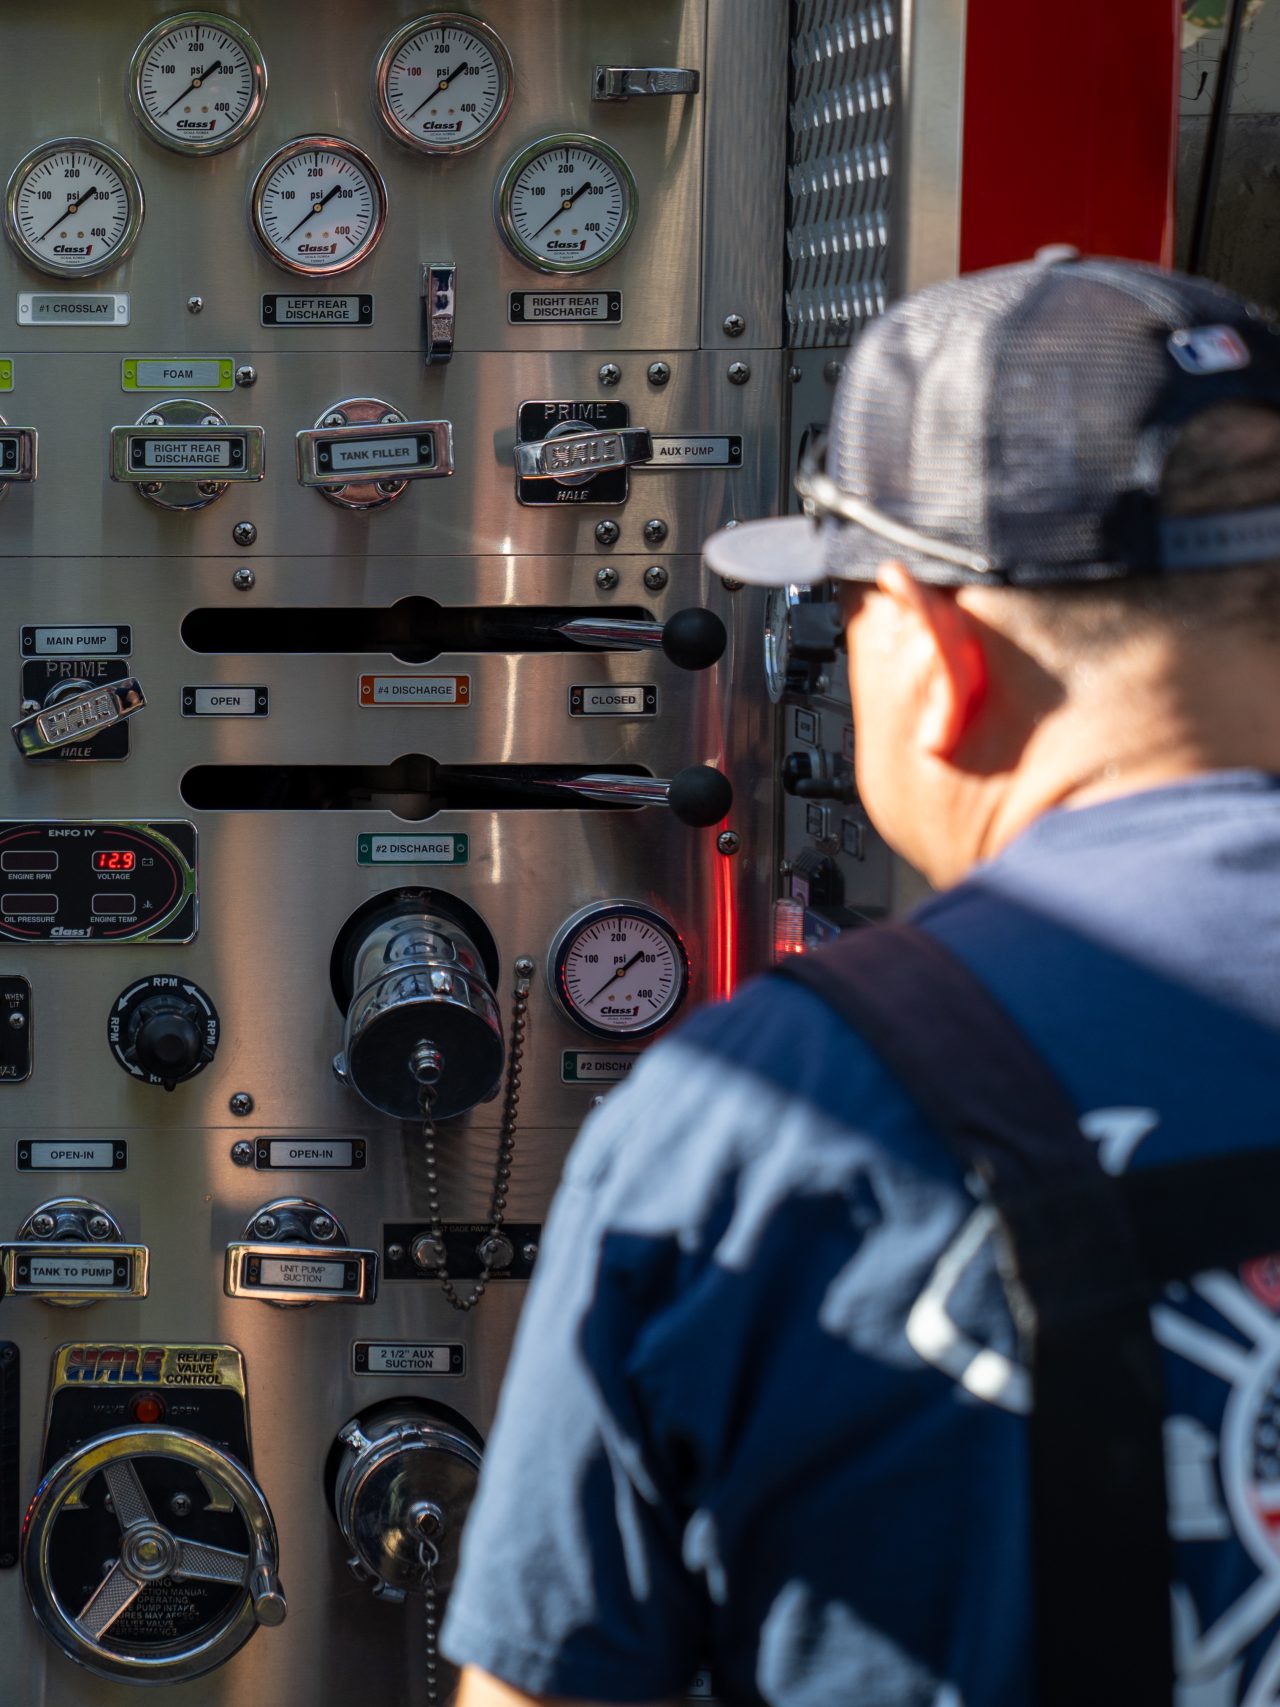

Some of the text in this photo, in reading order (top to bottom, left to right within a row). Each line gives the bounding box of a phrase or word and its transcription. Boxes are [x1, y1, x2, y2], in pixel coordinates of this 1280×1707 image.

[188, 43, 204, 52] 200
[434, 44, 450, 54] 200
[161, 65, 175, 74] 100
[190, 65, 204, 76] psi
[218, 65, 234, 74] 300
[407, 67, 421, 76] 100
[437, 67, 450, 78] psi
[464, 66, 480, 75] 300
[214, 103, 230, 112] 400
[460, 104, 476, 112] 400
[64, 169, 80, 178] 200
[307, 168, 323, 177] 200
[558, 165, 574, 174] 200
[37, 191, 52, 200] 100
[281, 191, 295, 200] 100
[337, 189, 353, 199] 300
[531, 187, 545, 196] 100
[560, 187, 574, 198] psi
[587, 186, 603, 195] 300
[66, 192, 80, 202] psi
[94, 191, 110, 201] 300
[310, 191, 323, 202] psi
[90, 228, 106, 237] 400
[335, 226, 350, 235] 400
[584, 223, 600, 232] 400
[287, 300, 347, 309] LEFT REAR
[532, 297, 599, 306] RIGHT REAR
[39, 304, 109, 314] #1 CROSSLAY
[533, 307, 598, 317] DISCHARGE
[285, 310, 350, 319] DISCHARGE
[163, 370, 193, 379] FOAM
[544, 403, 608, 420] PRIME
[153, 444, 221, 453] RIGHT REAR
[660, 446, 714, 456] AUX PUMP
[154, 454, 220, 463] DISCHARGE
[340, 447, 410, 462] TANK FILLER
[556, 490, 590, 501] HALE
[46, 636, 107, 646] MAIN PUMP
[46, 661, 108, 677] PRIME
[377, 685, 453, 695] #4 DISCHARGE
[210, 696, 241, 706] OPEN
[591, 695, 636, 705] CLOSED
[60, 747, 93, 758] HALE
[48, 829, 96, 838] ENFO IV
[375, 844, 450, 853] #2 DISCHARGE
[98, 852, 134, 869] 12.9
[610, 933, 627, 942] 200
[584, 954, 599, 964] 100
[613, 954, 627, 966] psi
[640, 954, 656, 964] 300
[153, 977, 178, 987] RPM
[5, 993, 24, 1001] WHEN
[637, 989, 653, 999] 400
[110, 1016, 120, 1042] RPM
[207, 1020, 216, 1045] RPM
[580, 1062, 592, 1071] #2
[50, 1151, 94, 1160] OPEN-IN
[289, 1149, 333, 1159] OPEN-IN
[32, 1268, 113, 1277] TANK TO PUMP
[280, 1264, 326, 1274] UNIT PUMP
[283, 1273, 322, 1283] SUCTION
[177, 1353, 219, 1363] RELIEF
[381, 1350, 387, 1358] 2
[412, 1350, 435, 1359] AUX
[177, 1363, 214, 1373] VALVE
[385, 1360, 433, 1368] SUCTION
[166, 1373, 222, 1385] CONTROL
